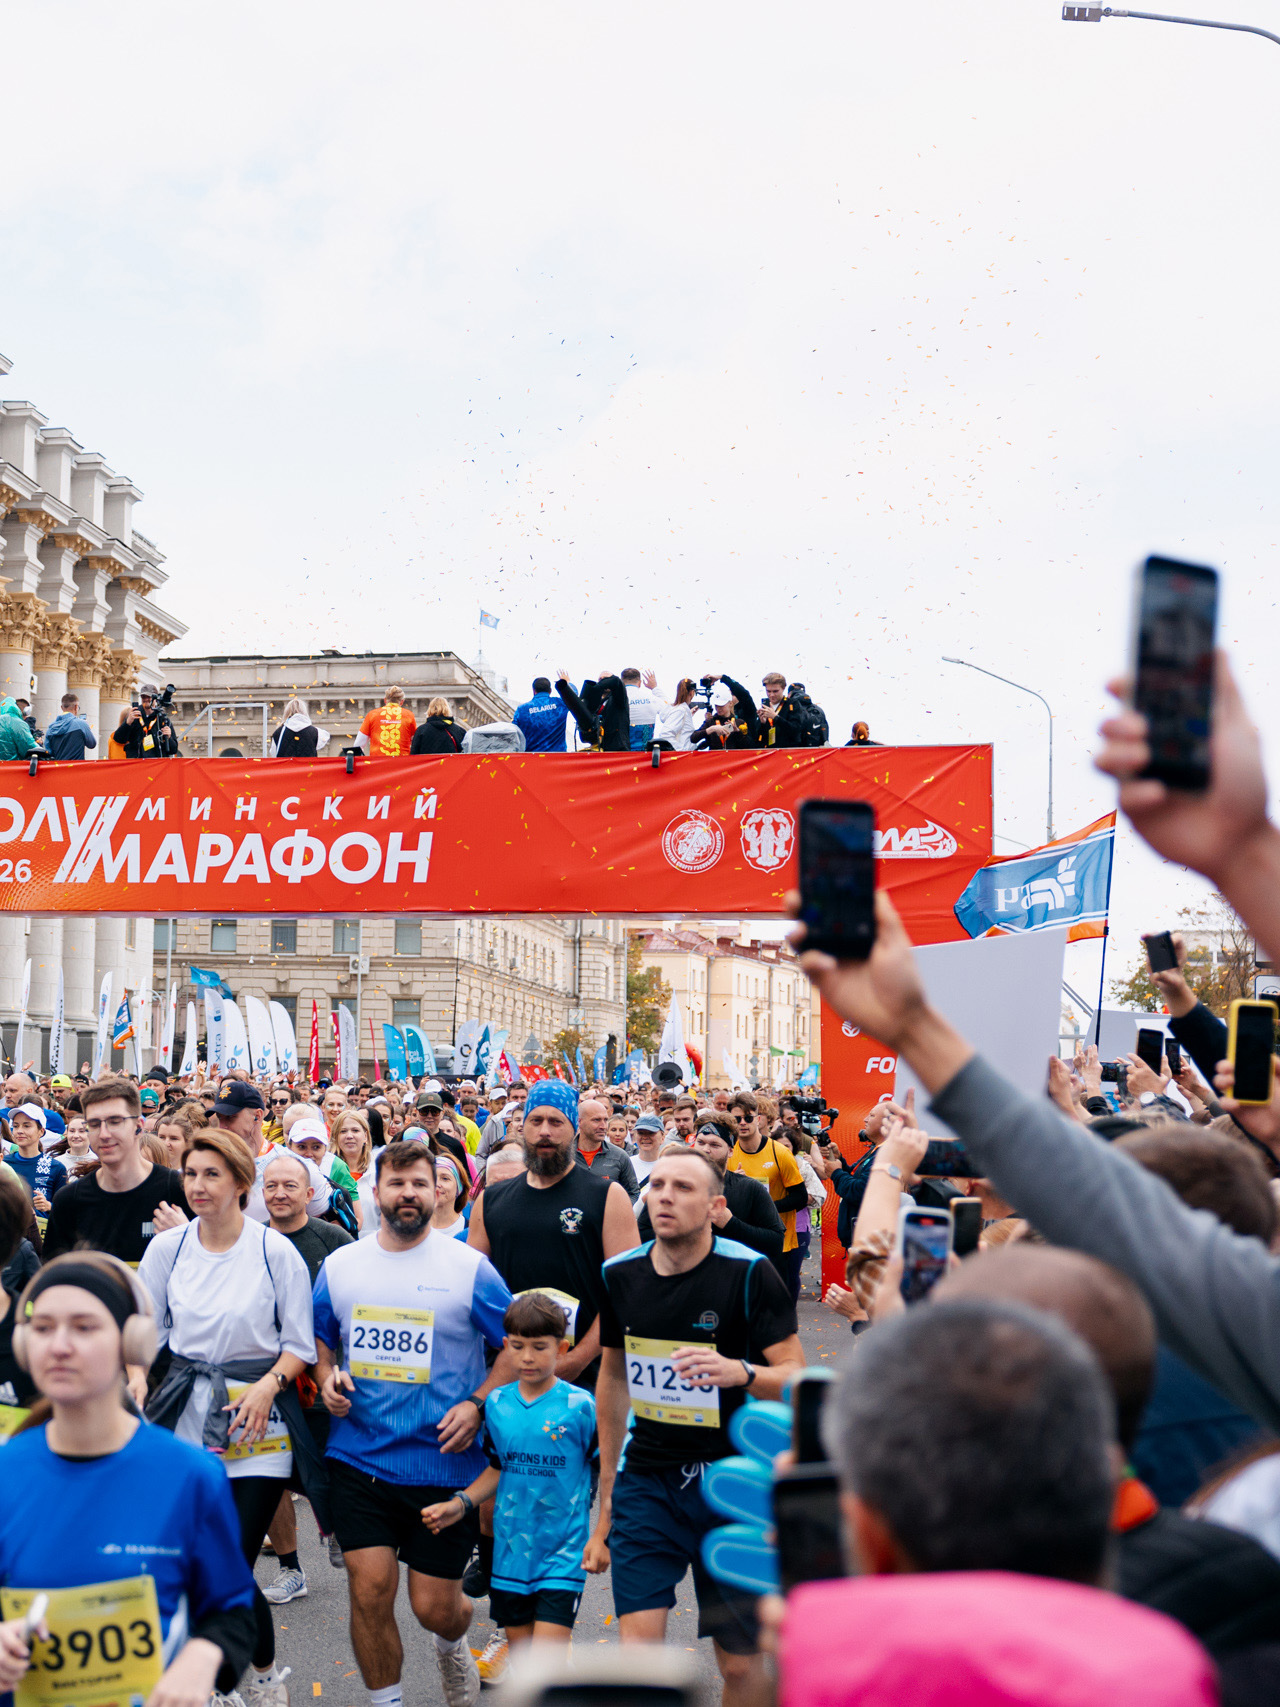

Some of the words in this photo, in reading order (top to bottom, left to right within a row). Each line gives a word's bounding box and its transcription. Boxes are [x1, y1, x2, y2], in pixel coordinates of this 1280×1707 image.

[528, 703, 557, 714] BELARUS
[135, 787, 438, 821] МИНСКИЙ
[70, 829, 433, 884] МАРАФОН
[865, 1056, 897, 1074] FO
[353, 1326, 428, 1354] 23886
[376, 1354, 402, 1362] СЕРГЕЙ
[660, 1394, 682, 1402] ИЛЬЯ
[542, 1455, 566, 1466] KIDS
[528, 1468, 557, 1478] SCHOOL
